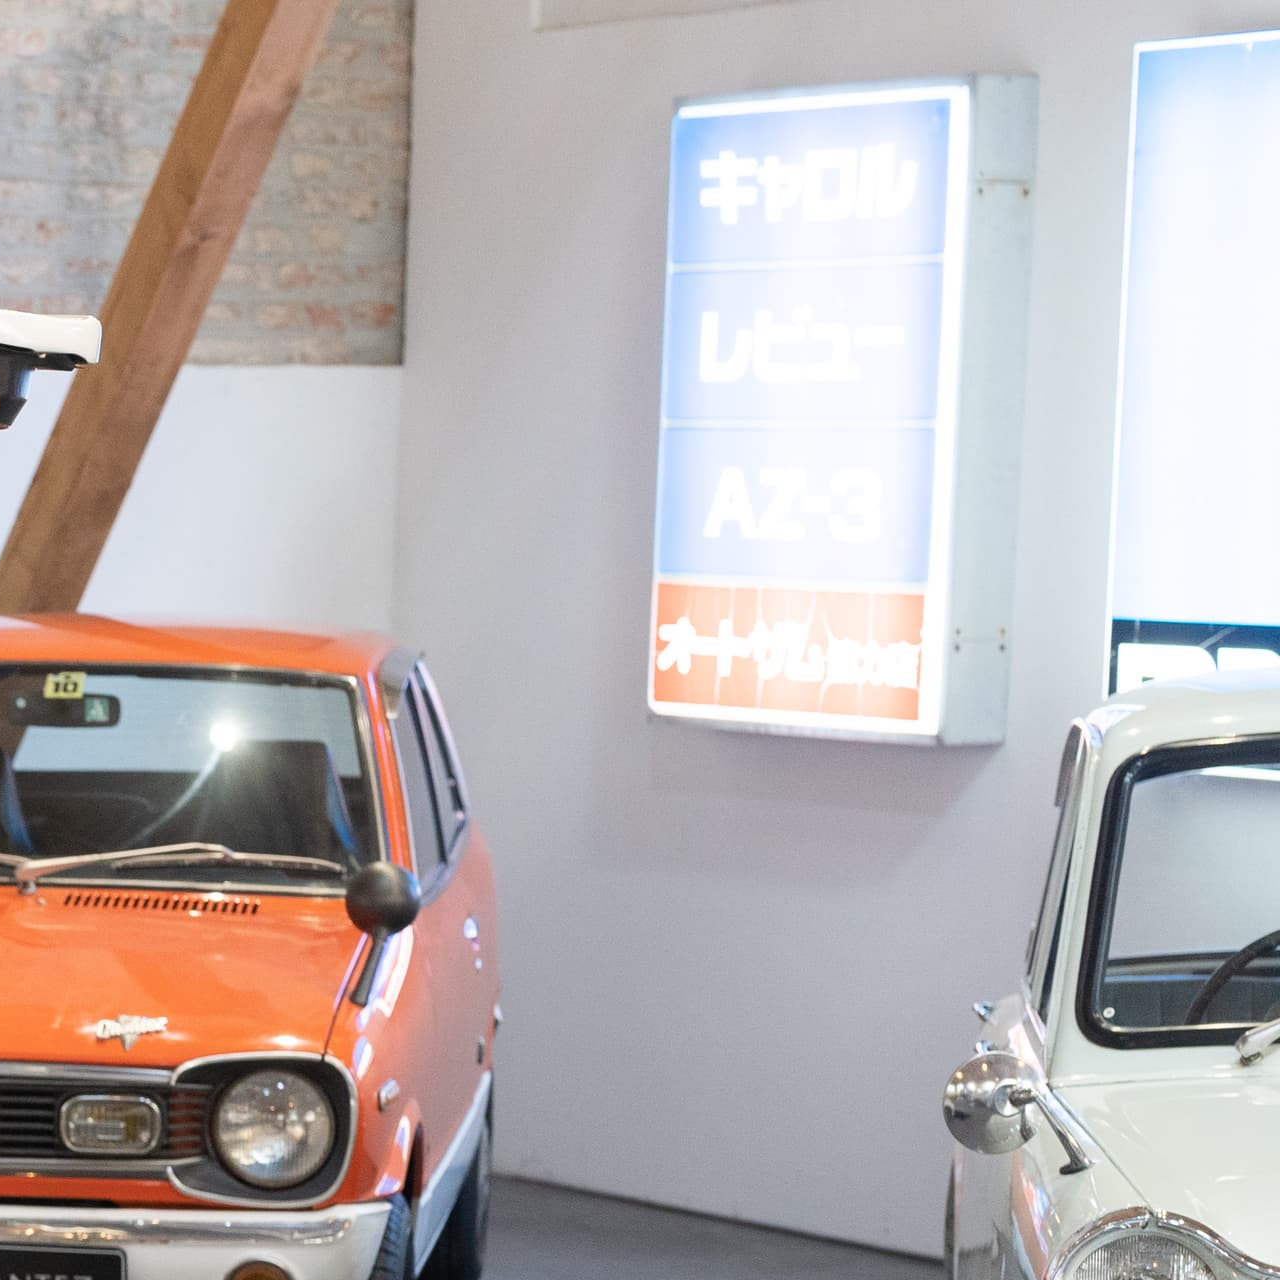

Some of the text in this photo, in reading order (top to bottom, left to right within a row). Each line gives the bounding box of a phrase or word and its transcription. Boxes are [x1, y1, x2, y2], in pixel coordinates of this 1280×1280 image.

[700, 143, 918, 224] キャロル
[699, 304, 905, 383] レビュー
[703, 466, 882, 543] AZ-3
